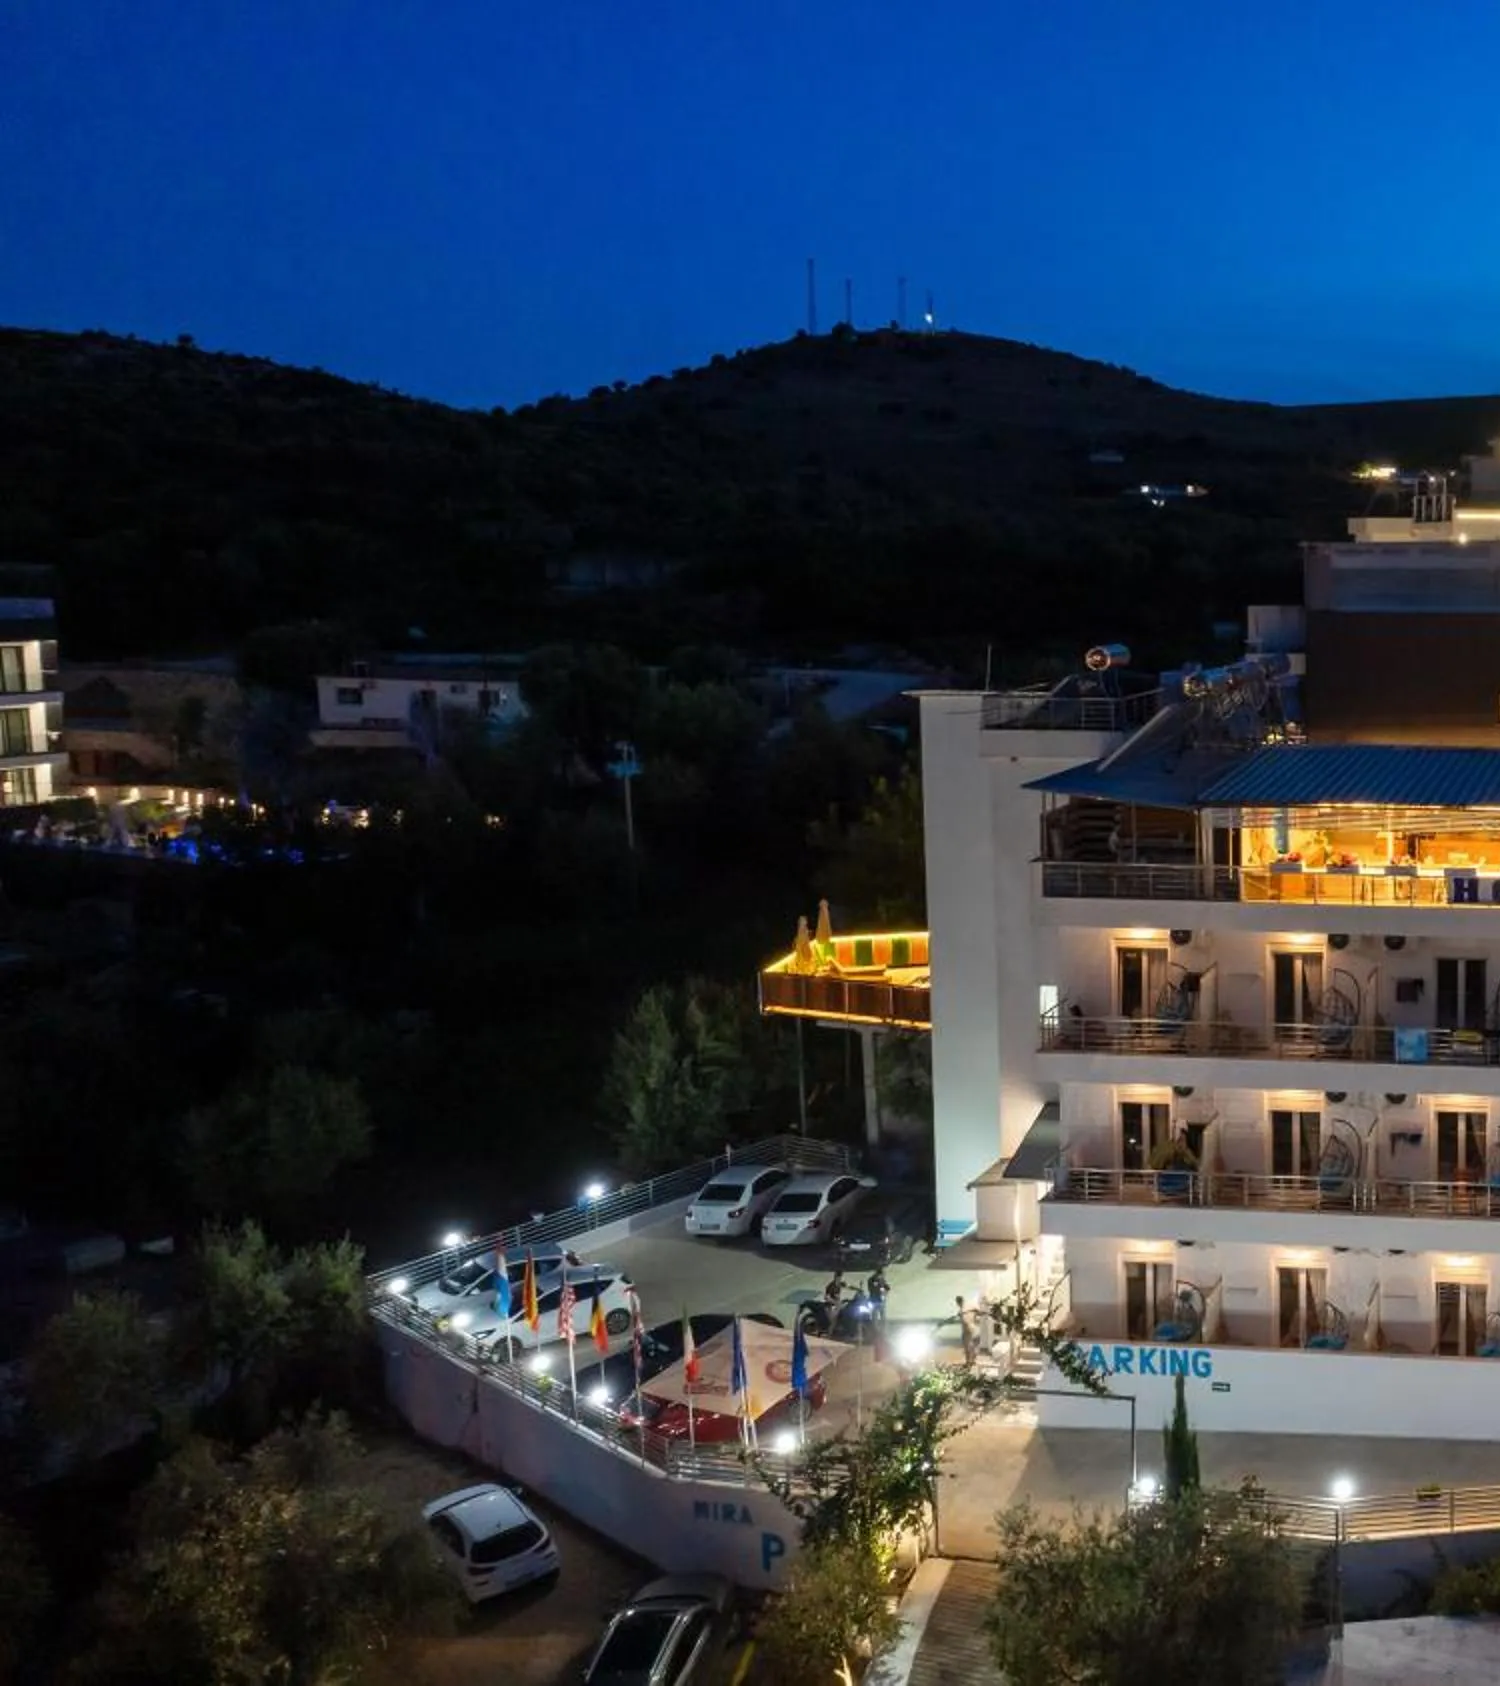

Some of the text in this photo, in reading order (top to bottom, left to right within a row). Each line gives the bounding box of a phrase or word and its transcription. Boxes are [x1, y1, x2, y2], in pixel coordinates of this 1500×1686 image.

[1068, 1343, 1213, 1378] ARKING
[694, 1500, 753, 1525] MIRA
[761, 1532, 785, 1572] P
